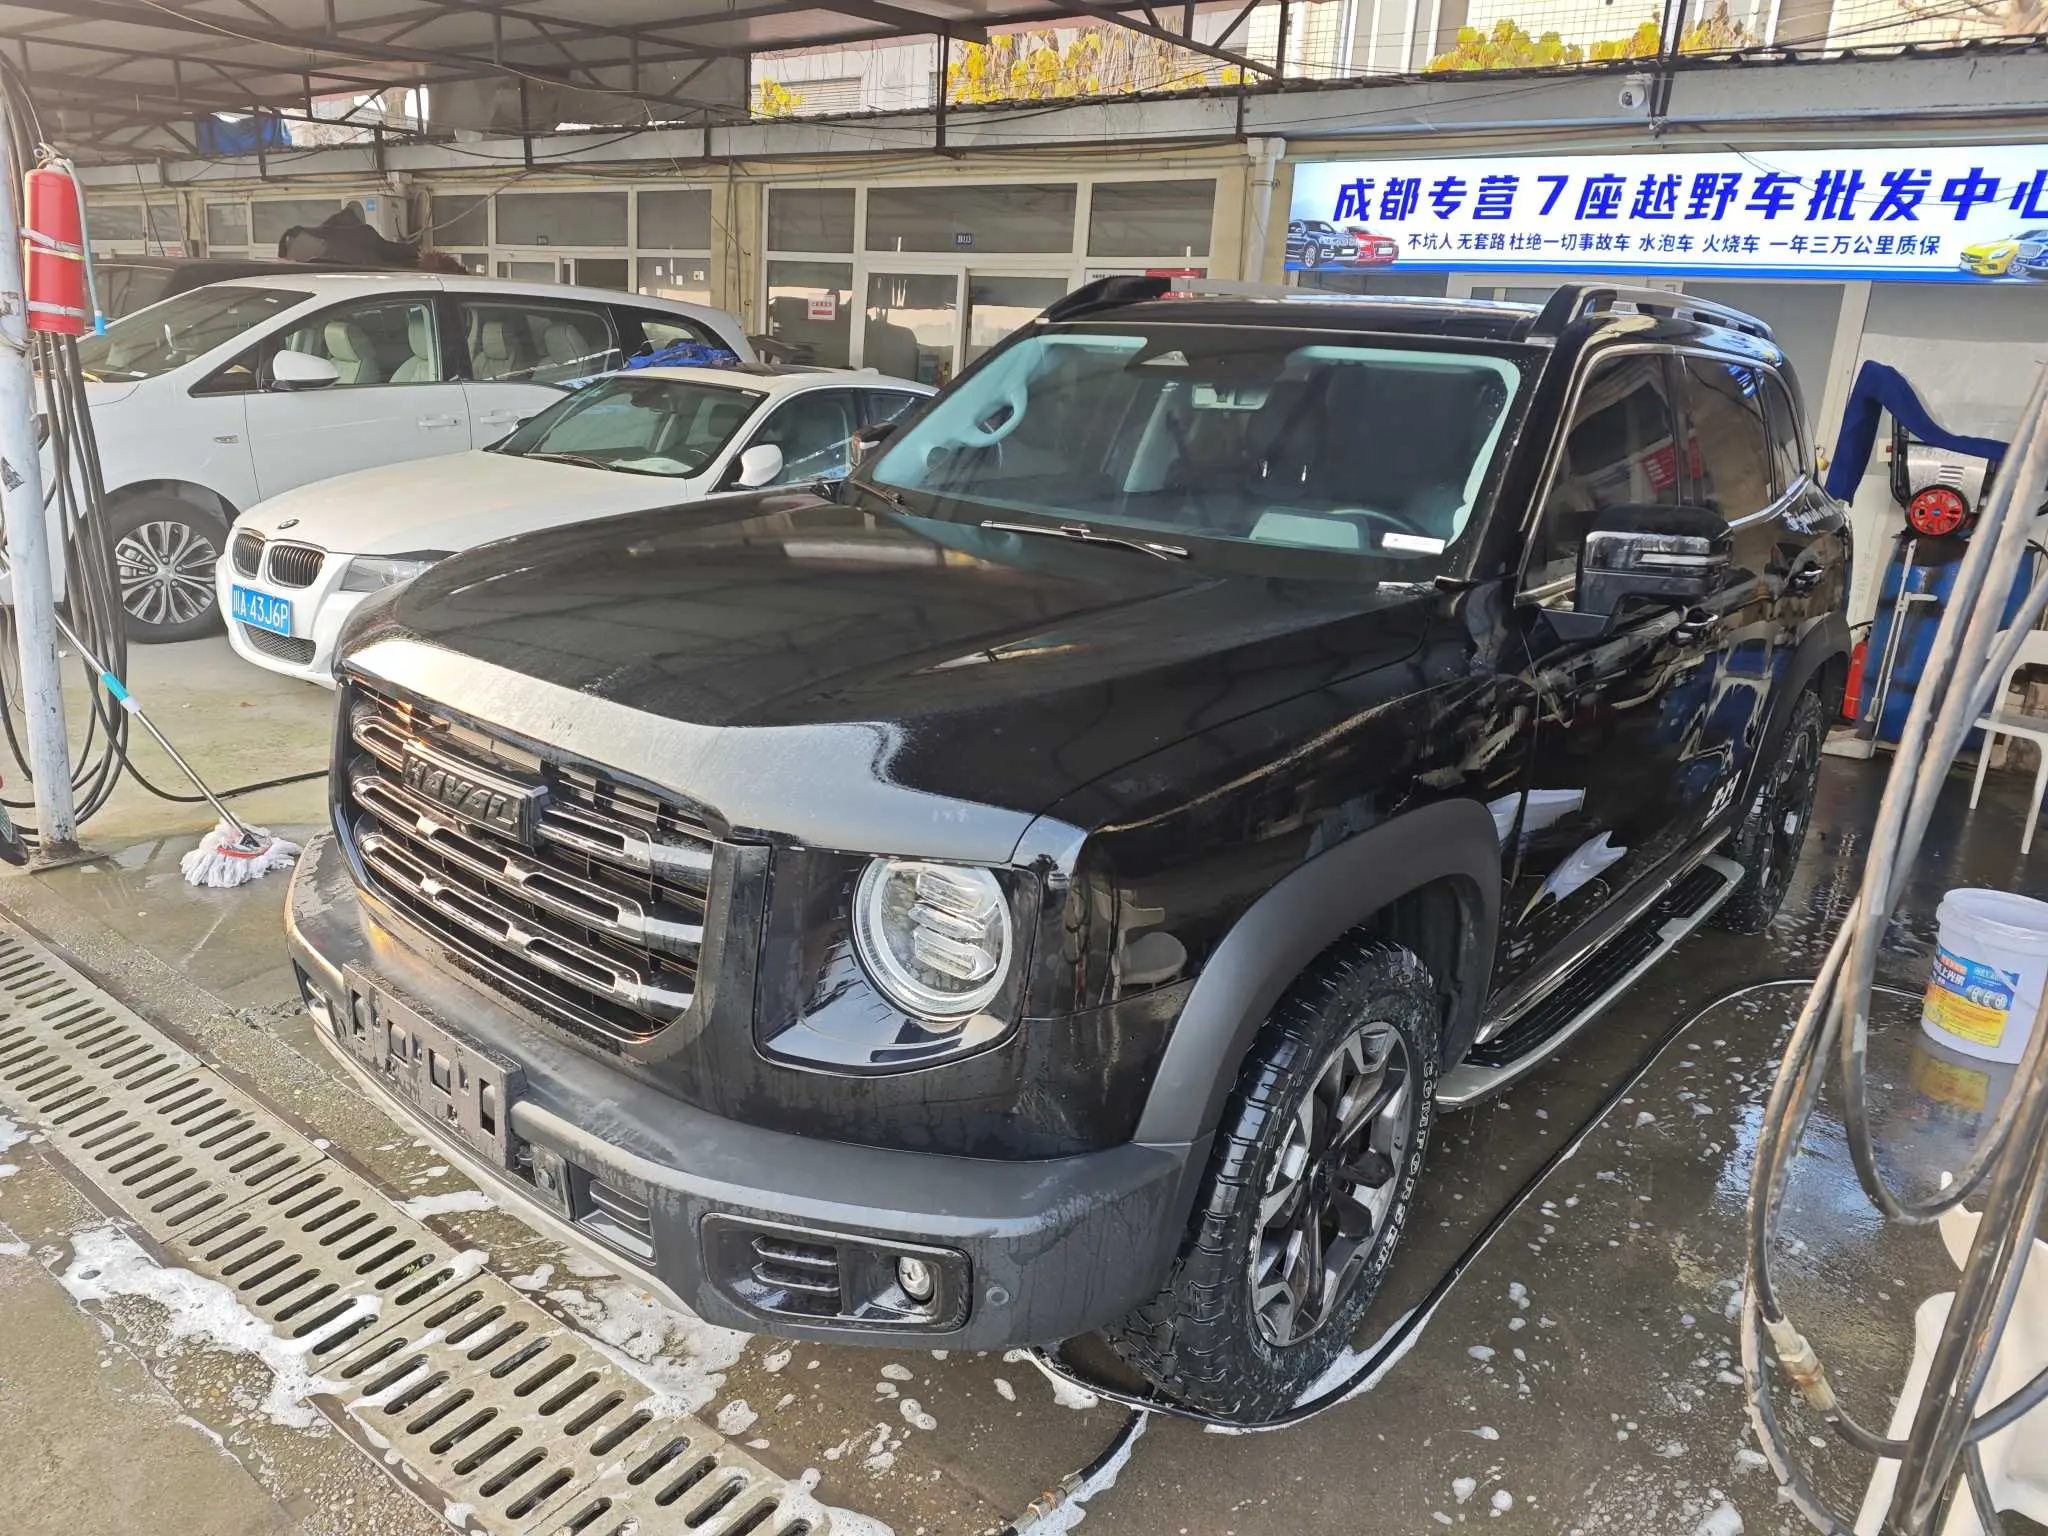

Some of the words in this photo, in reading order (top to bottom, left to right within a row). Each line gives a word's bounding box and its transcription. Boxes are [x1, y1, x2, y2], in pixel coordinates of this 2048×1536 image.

[1408, 233, 1453, 251] 不坑人
[1457, 233, 1506, 251] 无套路
[1509, 233, 1631, 252] 杜绝一切事故车
[1638, 233, 1694, 253] 水泡车
[1702, 233, 1760, 254] 火烧车
[1769, 234, 1941, 256] 一年三万公里质保
[403, 755, 517, 828] HAVAL
